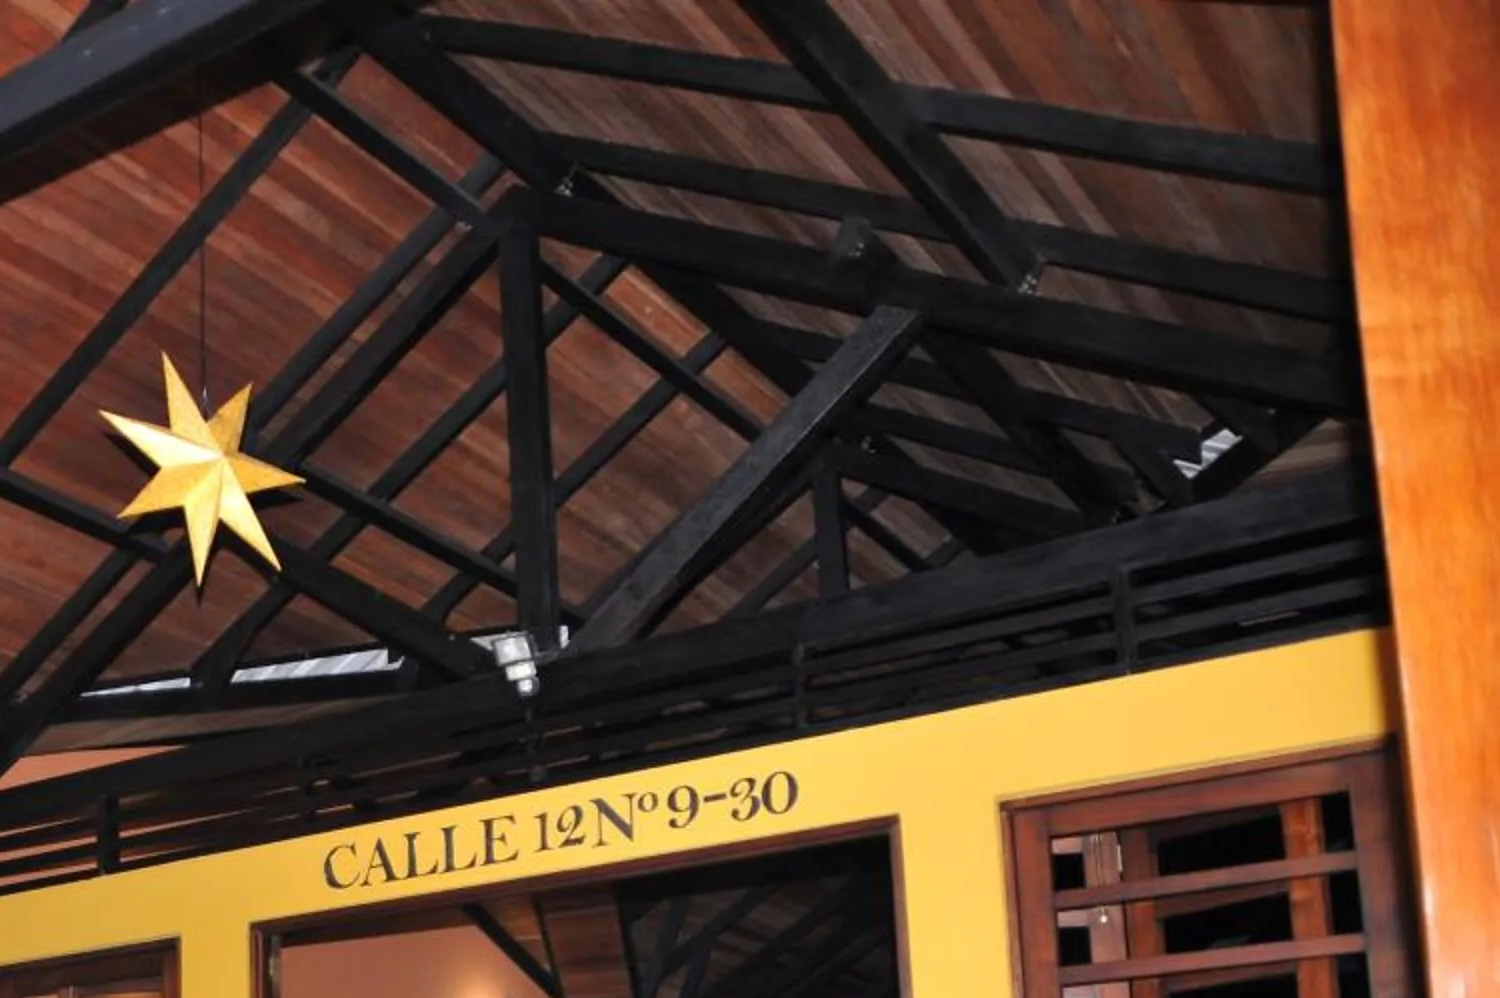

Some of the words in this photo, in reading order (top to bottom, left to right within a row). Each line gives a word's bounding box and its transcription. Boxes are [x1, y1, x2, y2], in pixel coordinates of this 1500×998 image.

[323, 815, 519, 889] CALLE
[534, 805, 585, 851] 12
[667, 771, 798, 829] 9-30
